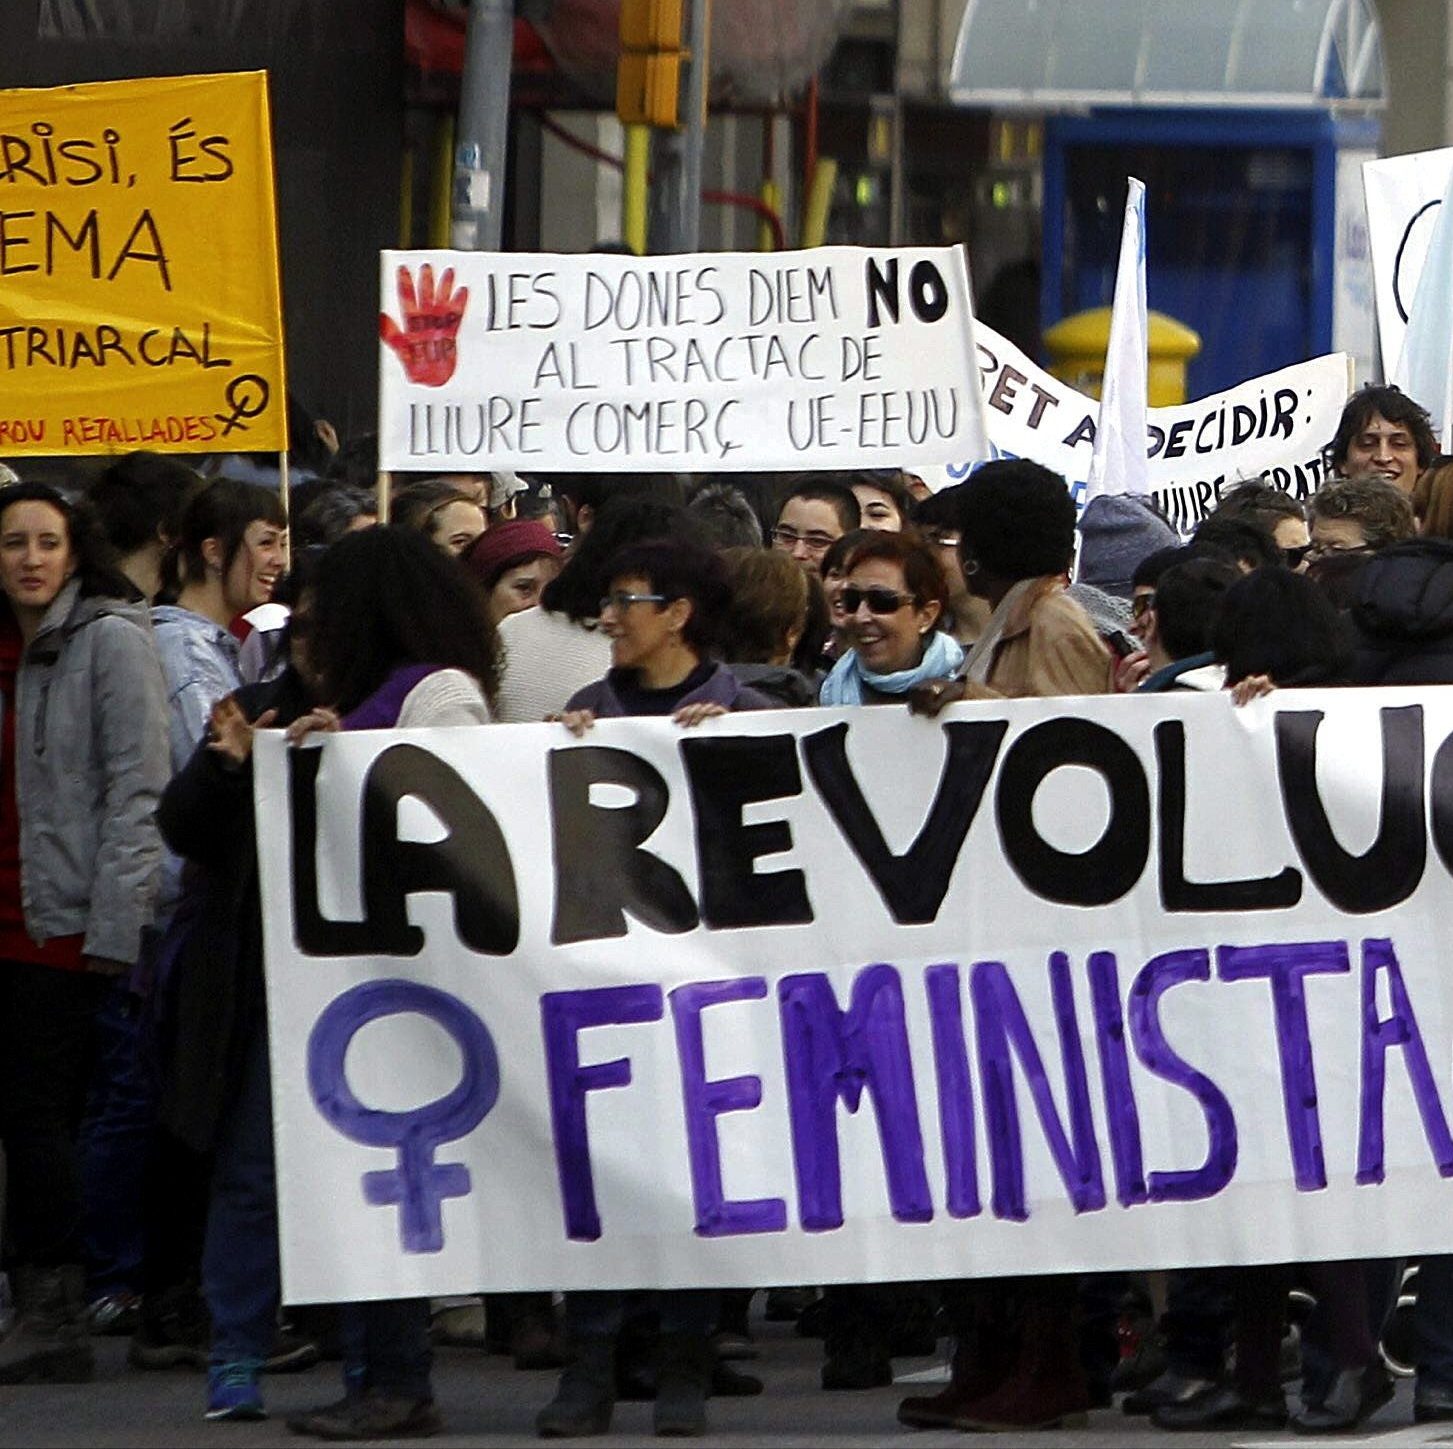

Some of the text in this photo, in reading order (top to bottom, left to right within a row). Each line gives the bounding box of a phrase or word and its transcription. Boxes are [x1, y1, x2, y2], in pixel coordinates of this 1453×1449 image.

[169, 117, 235, 184] ÉS
[0, 208, 173, 293] EMA
[485, 256, 950, 333] LES DONES DIEM NO
[0, 322, 233, 371] TRIARCAL
[532, 334, 884, 390] AL TRACTAC DE
[63, 415, 217, 447] RETALLADES
[408, 387, 960, 459] LLIURE COMERÇ UE-EEUU
[288, 742, 520, 959] LA
